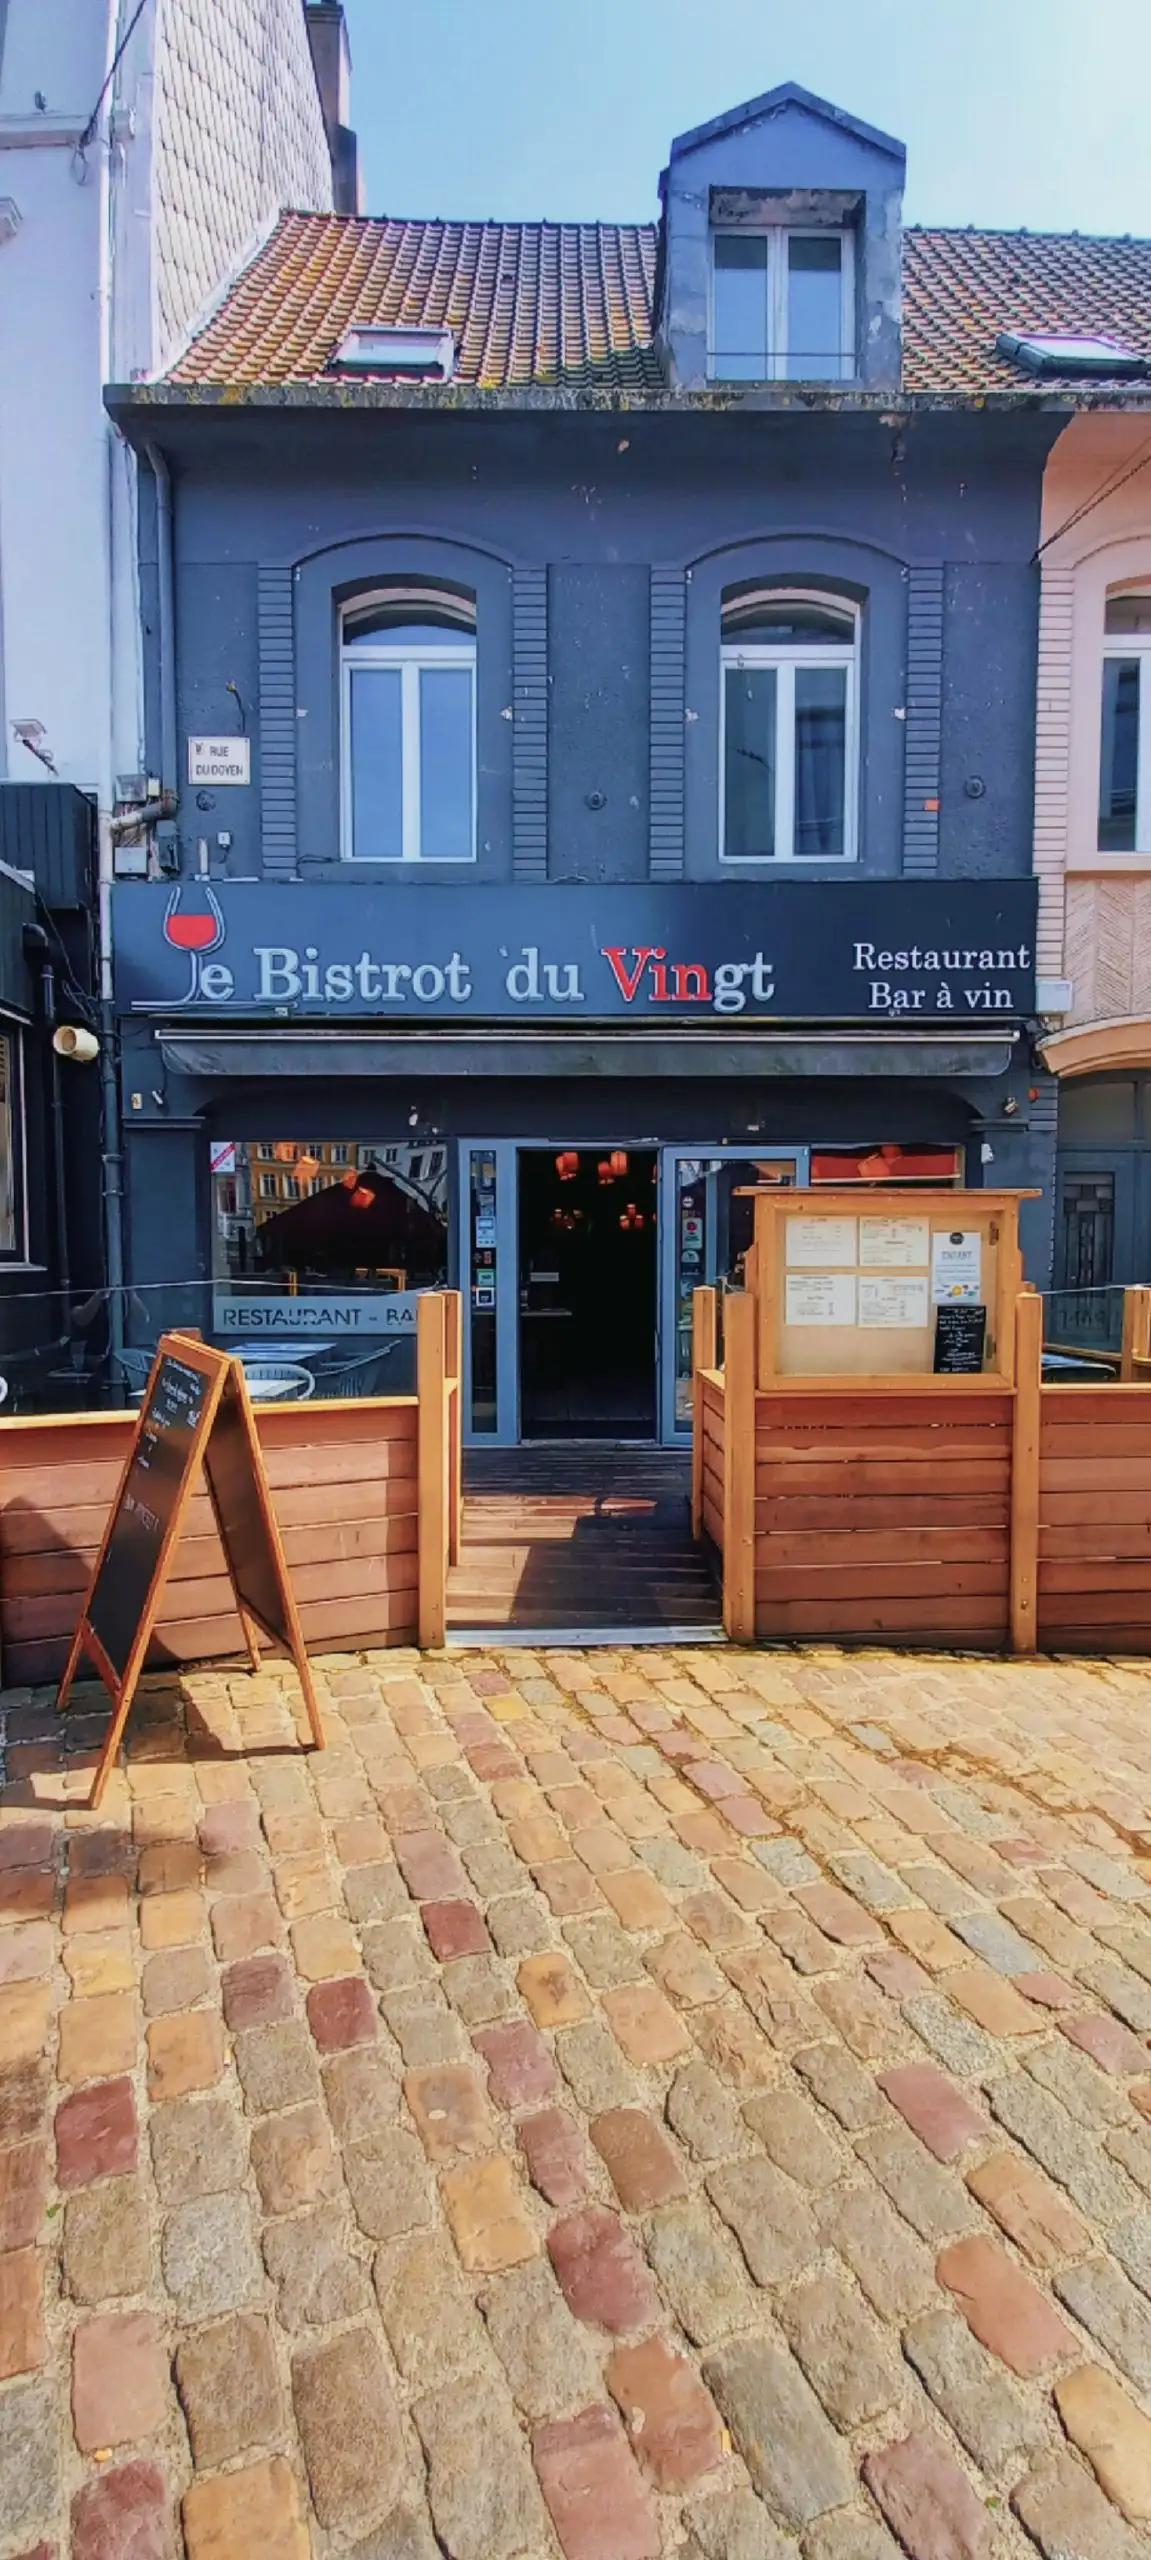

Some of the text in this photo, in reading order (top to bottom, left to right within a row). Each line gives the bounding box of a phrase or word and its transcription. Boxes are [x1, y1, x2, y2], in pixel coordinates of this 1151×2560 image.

[209, 745, 229, 757] RUE
[852, 942, 1031, 971] Restaurant
[253, 947, 472, 1002] Bistrot
[505, 947, 585, 1003] du
[601, 946, 775, 1014] Vingt
[868, 981, 1014, 1010] Bar à vin
[223, 1308, 362, 1326] RESTAURANT
[386, 1308, 419, 1326] BA
